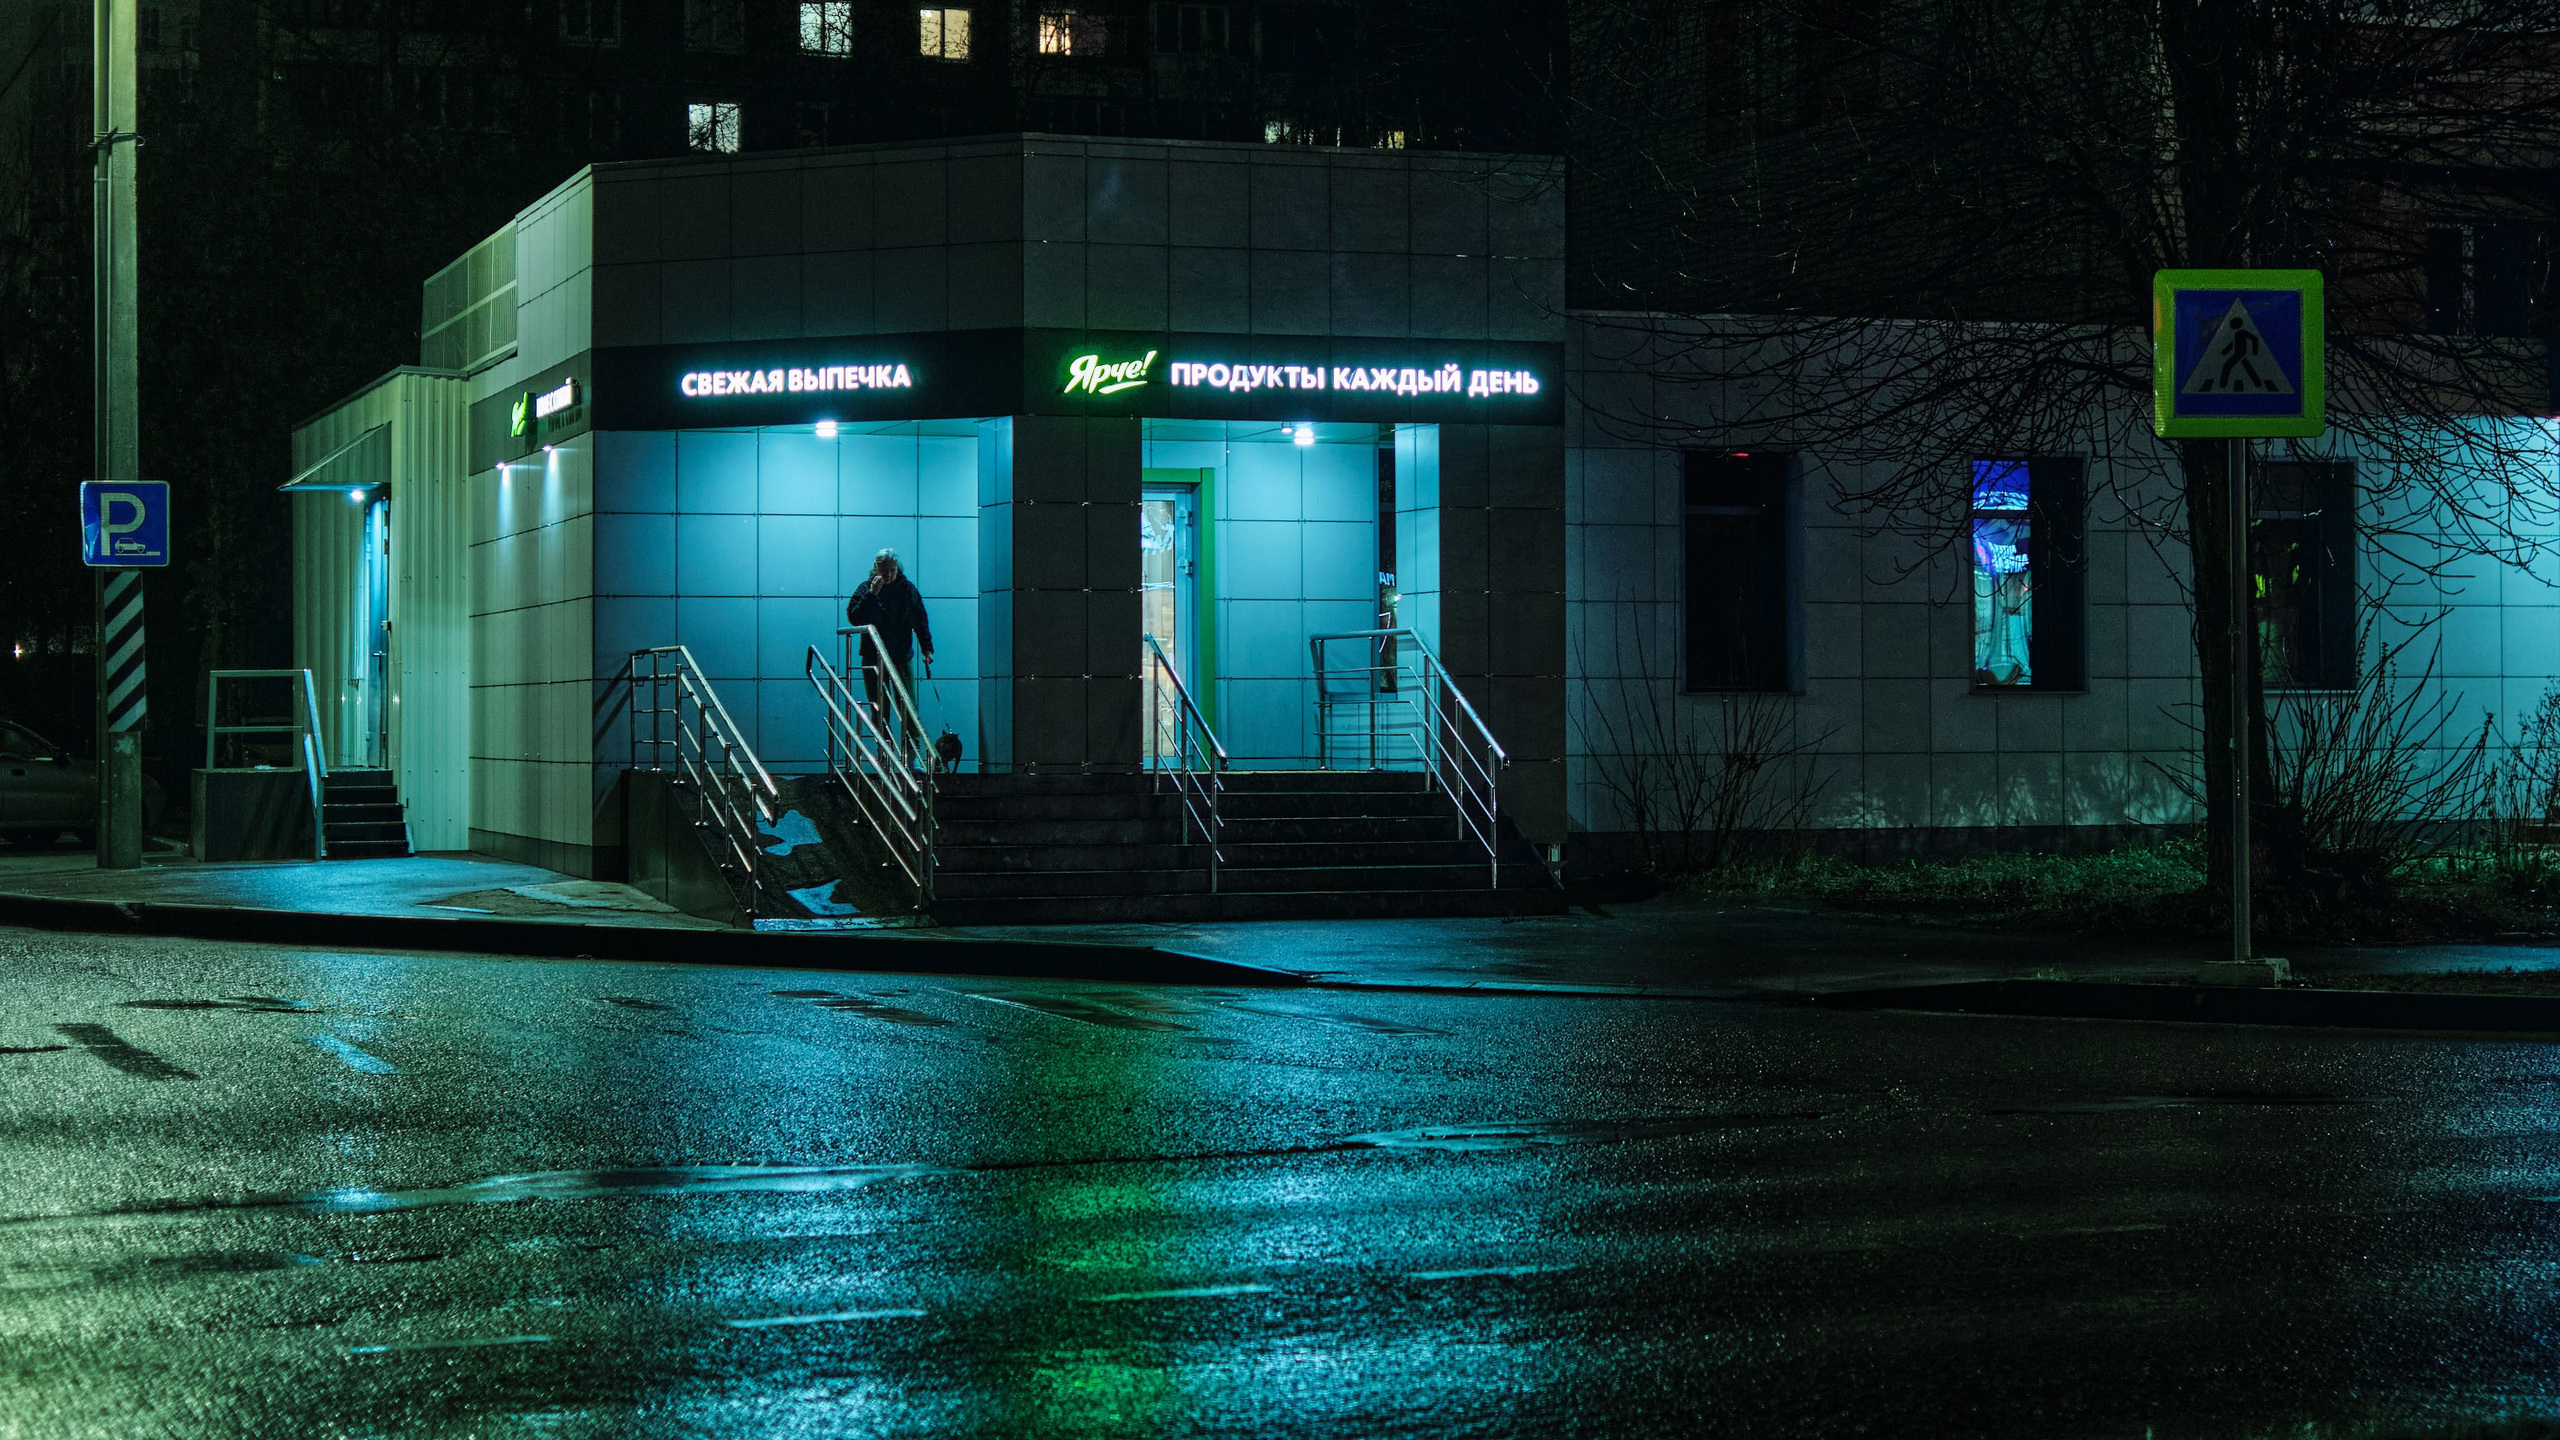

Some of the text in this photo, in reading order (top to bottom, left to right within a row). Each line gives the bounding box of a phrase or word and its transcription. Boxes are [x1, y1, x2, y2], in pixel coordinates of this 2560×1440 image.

[681, 363, 912, 396] СВЕЖАЯ ВЫПЕЧКА
[1063, 350, 1540, 398] Ярче! ПРОДУКТЫ КАЖДЫЙ ДЕНЬ
[101, 493, 146, 556] P
